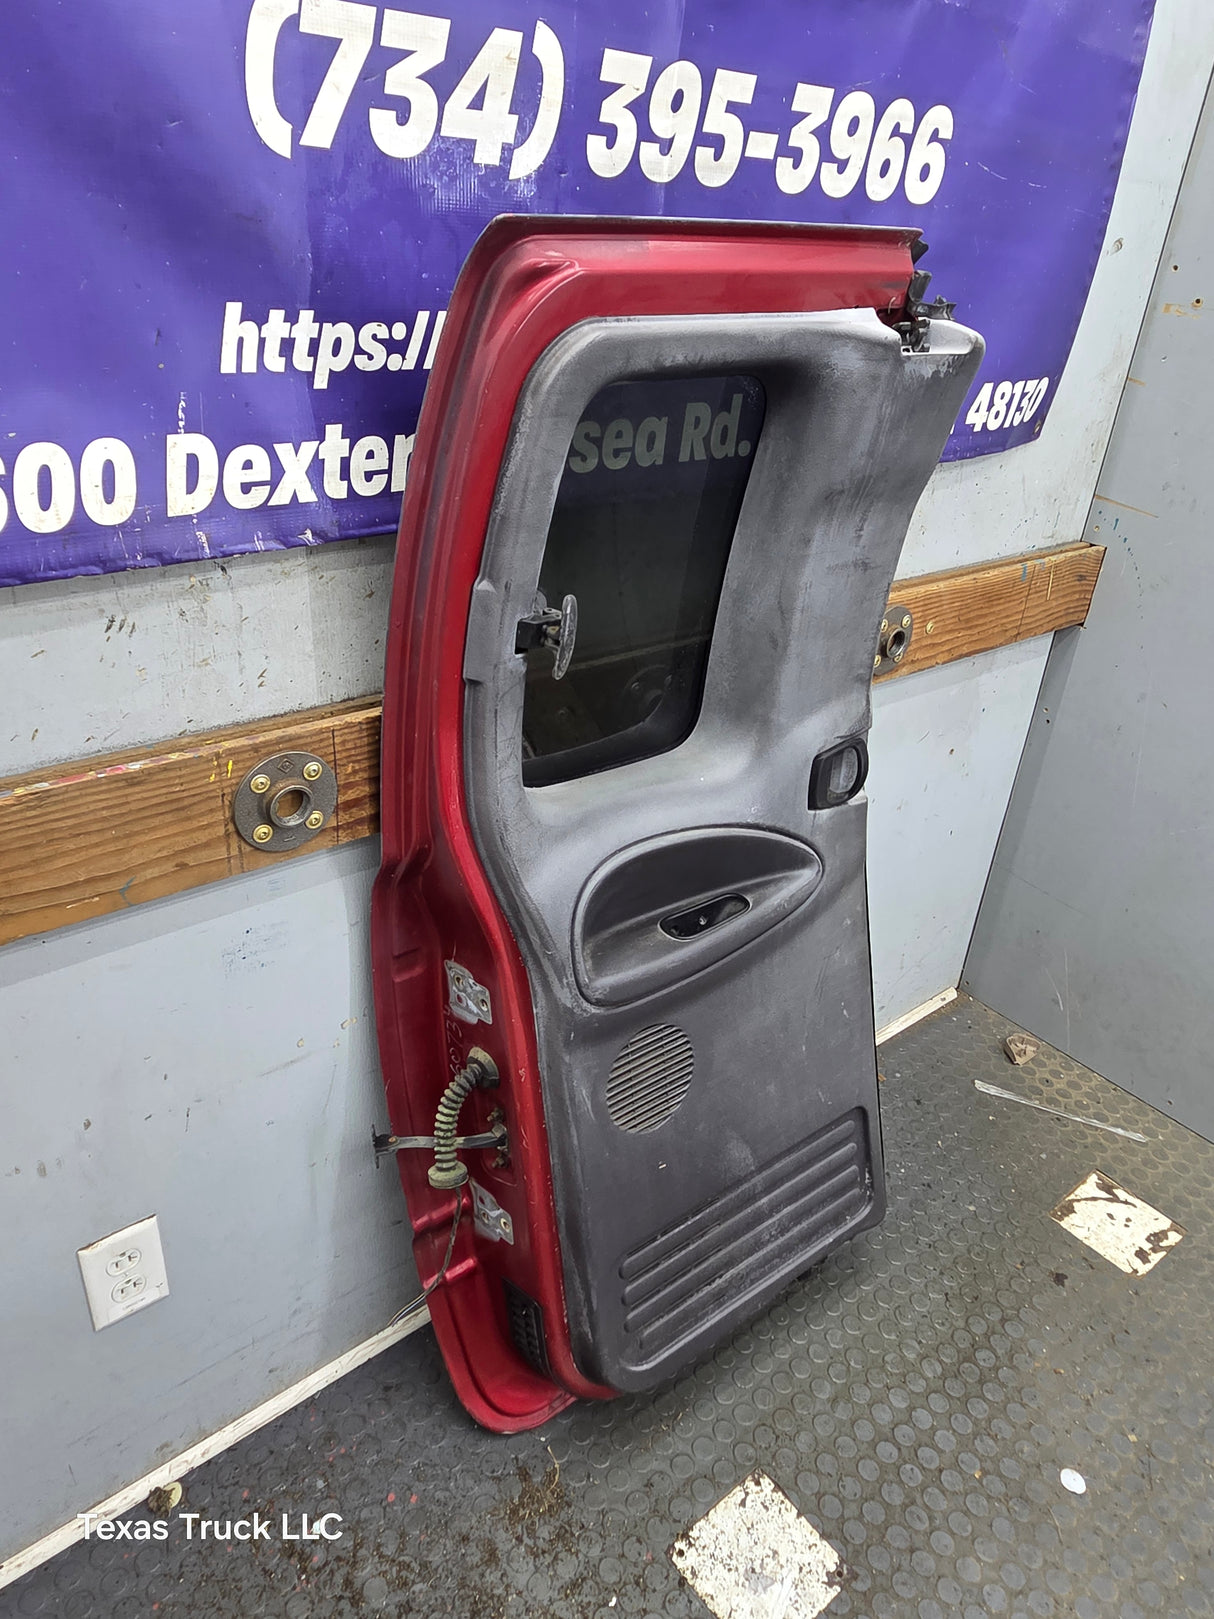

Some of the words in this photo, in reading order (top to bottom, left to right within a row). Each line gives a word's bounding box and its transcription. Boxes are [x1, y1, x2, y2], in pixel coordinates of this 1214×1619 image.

[244, 0, 565, 181] (734)
[586, 48, 954, 205] 395-3966
[219, 301, 447, 390] https://
[678, 393, 752, 463] Rd.
[965, 376, 1049, 432] 48130
